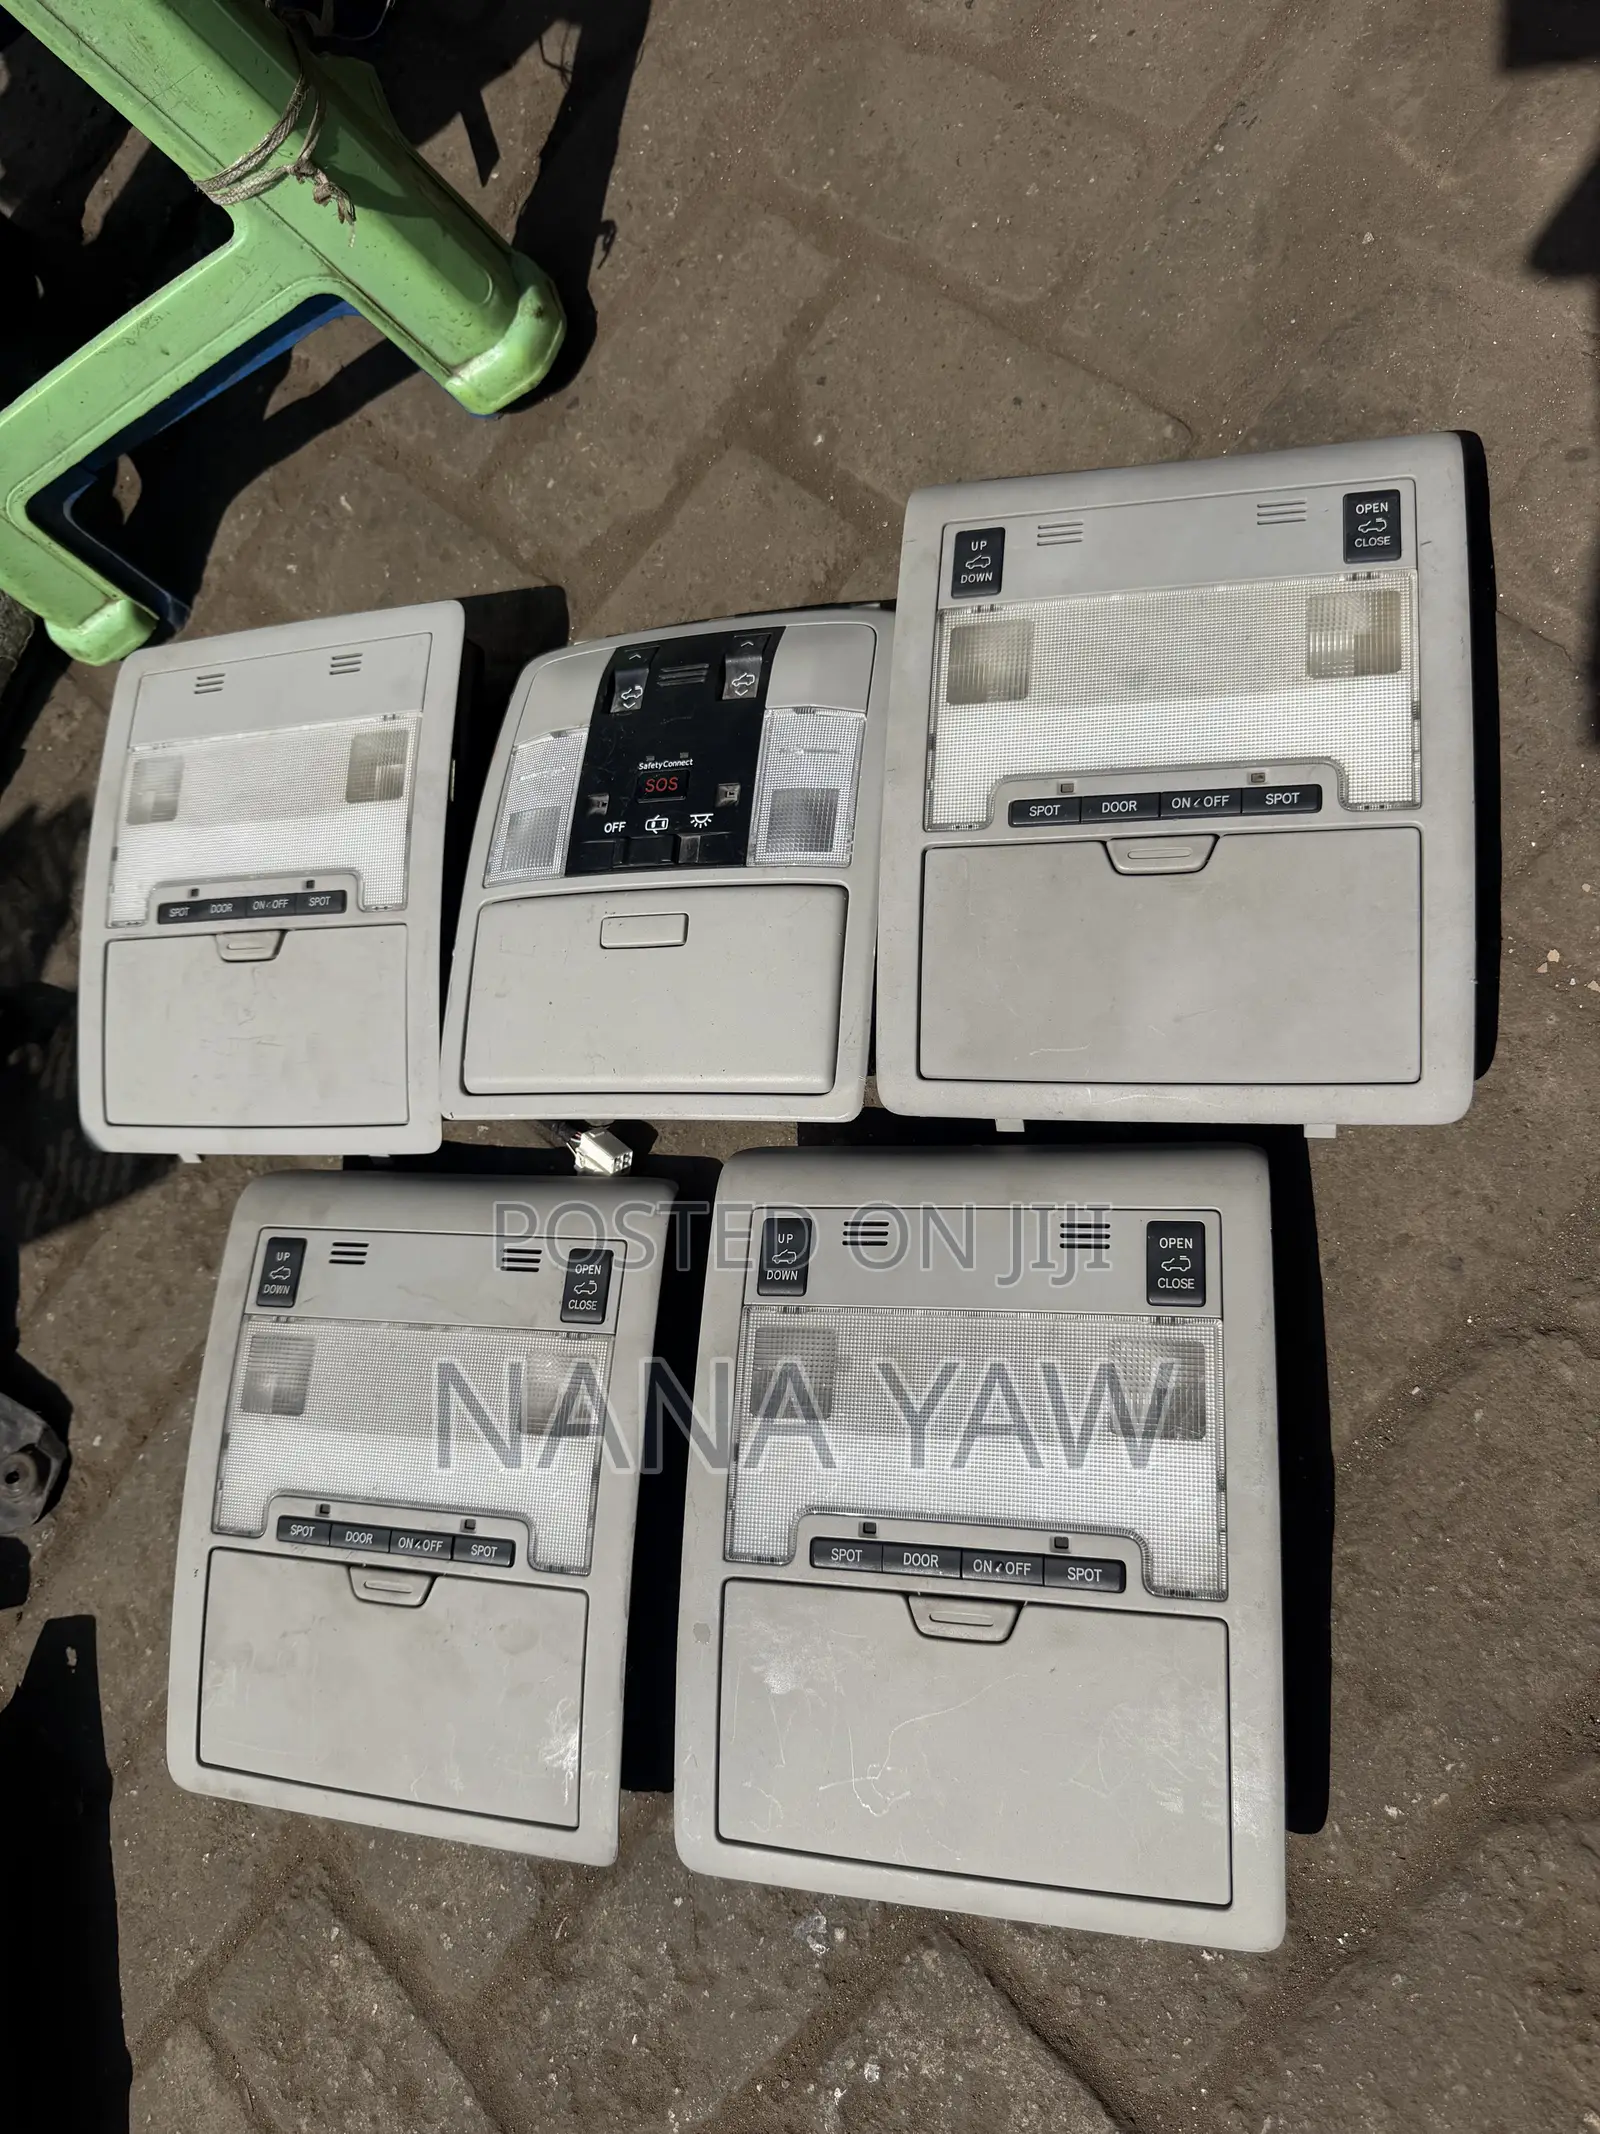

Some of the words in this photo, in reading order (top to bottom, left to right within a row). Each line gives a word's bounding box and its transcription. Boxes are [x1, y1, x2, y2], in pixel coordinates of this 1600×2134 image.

[1355, 502, 1389, 515] OPEN
[971, 540, 987, 551] UP
[1354, 535, 1391, 548] CLOSE
[960, 571, 993, 584] DOWN
[645, 776, 679, 793] SOS
[1029, 805, 1061, 817] SPOT
[1101, 800, 1137, 814] DOOR
[1265, 792, 1300, 805] SPOT
[604, 821, 627, 834] OFF
[169, 907, 190, 918] SPOT
[210, 903, 233, 914] DOOR
[308, 895, 331, 907] SPOT
[778, 1233, 794, 1244] UP
[1159, 1237, 1193, 1249] OPEN
[277, 1251, 291, 1261] UP
[575, 1264, 601, 1275] OPEN
[766, 1269, 798, 1281] DOWN
[1157, 1277, 1195, 1289] CLOSE
[263, 1284, 291, 1295] DOWN
[568, 1299, 598, 1311] CLOSE
[290, 1524, 315, 1538] SPOT
[345, 1532, 373, 1545] DOOR
[470, 1544, 498, 1559] SPOT
[831, 1548, 863, 1562] SPOT
[903, 1552, 939, 1568] DOOR
[1067, 1567, 1102, 1582] SPOT
